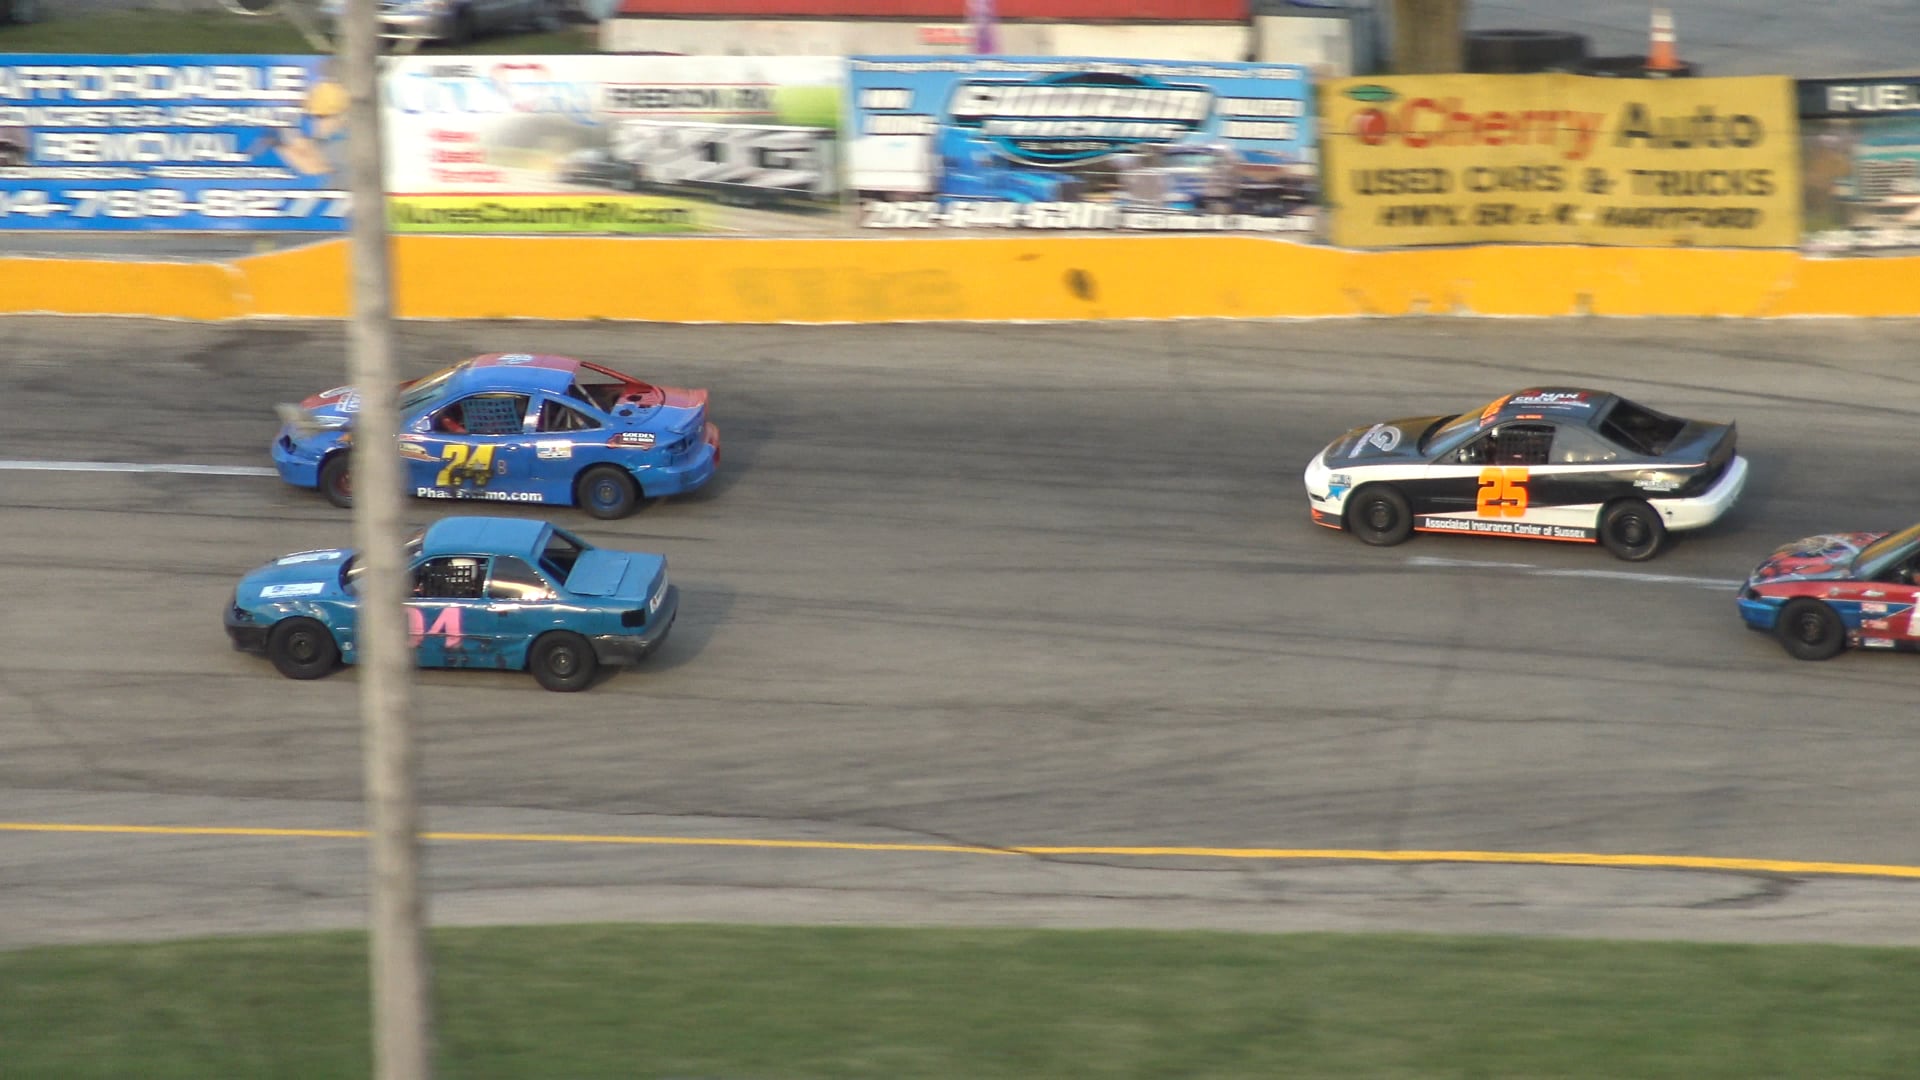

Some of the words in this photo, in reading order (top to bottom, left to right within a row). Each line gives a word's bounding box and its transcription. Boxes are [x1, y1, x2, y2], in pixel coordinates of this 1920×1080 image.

[1398, 98, 1602, 160] Cherry
[1614, 101, 1761, 149] Auto
[1354, 167, 1451, 196] USED
[1466, 165, 1567, 195] CARS
[1585, 167, 1614, 196] &
[1630, 168, 1773, 198] TRUCKS
[436, 443, 495, 487] 24
[1477, 466, 1530, 518] 25
[1425, 518, 1469, 530] Associated
[1471, 520, 1513, 533] Insurance
[1514, 523, 1541, 535] Center
[1543, 525, 1552, 535] of
[1554, 526, 1585, 538] Sussex
